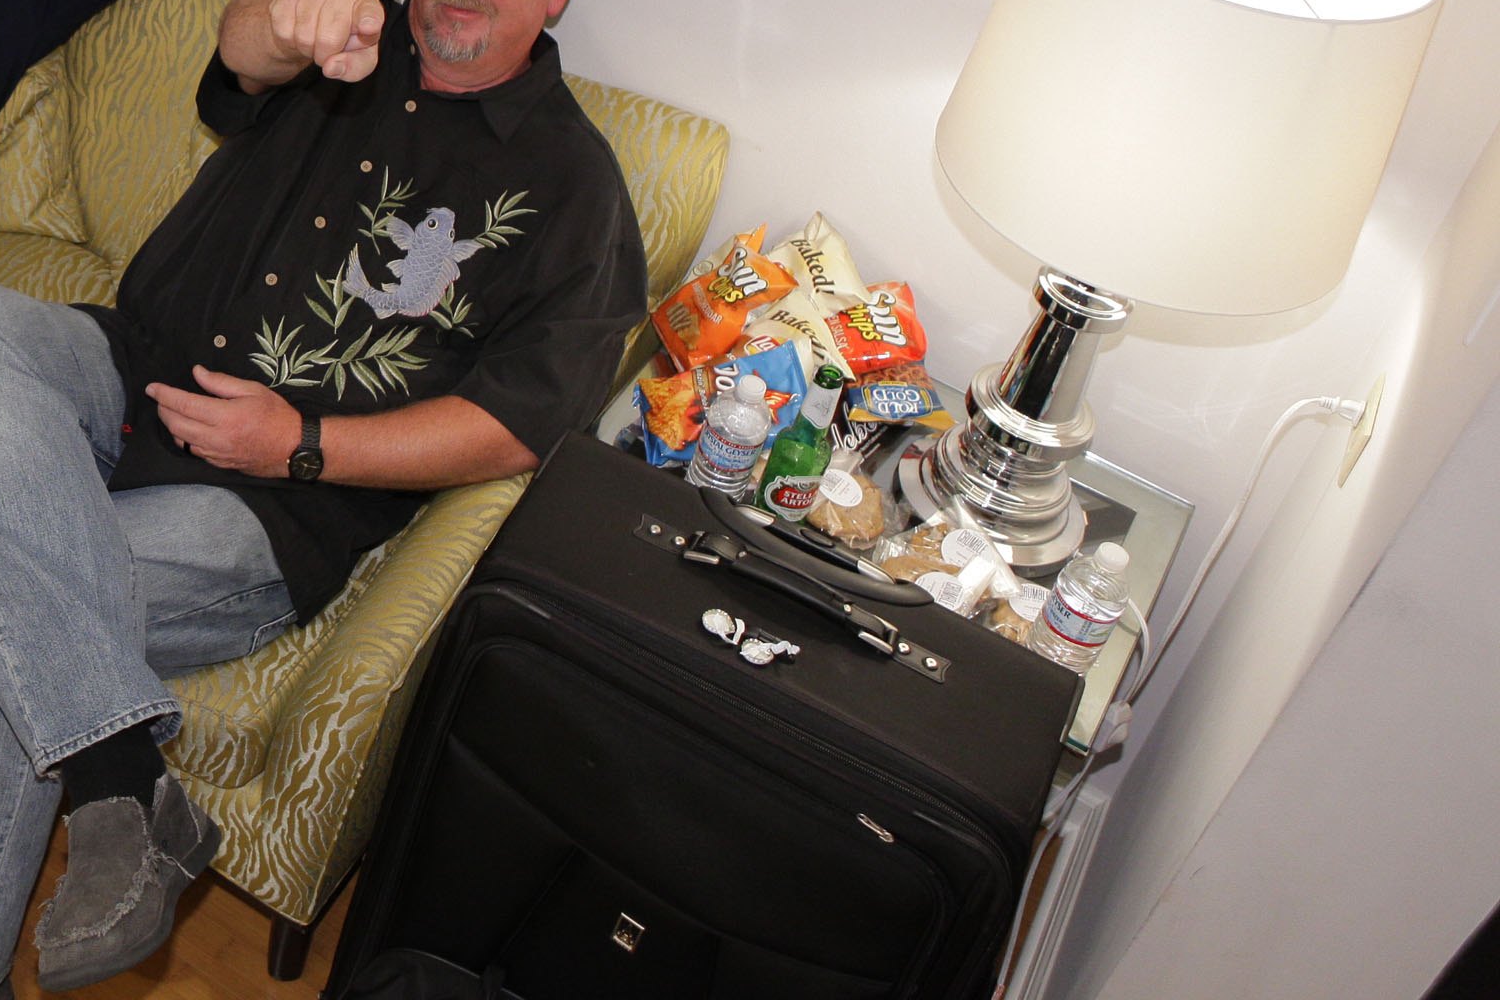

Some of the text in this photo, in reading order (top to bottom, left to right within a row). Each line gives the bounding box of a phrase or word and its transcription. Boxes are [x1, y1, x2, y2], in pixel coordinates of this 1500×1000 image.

[717, 247, 768, 298] Sun
[790, 238, 836, 297] Baked!
[708, 276, 744, 303] Chips
[867, 289, 908, 347] Sun
[752, 336, 776, 352] La
[873, 388, 920, 402] GOLD
[878, 400, 918, 413] ROLD
[783, 489, 814, 500] STELL
[956, 529, 989, 554] CRUMBLE
